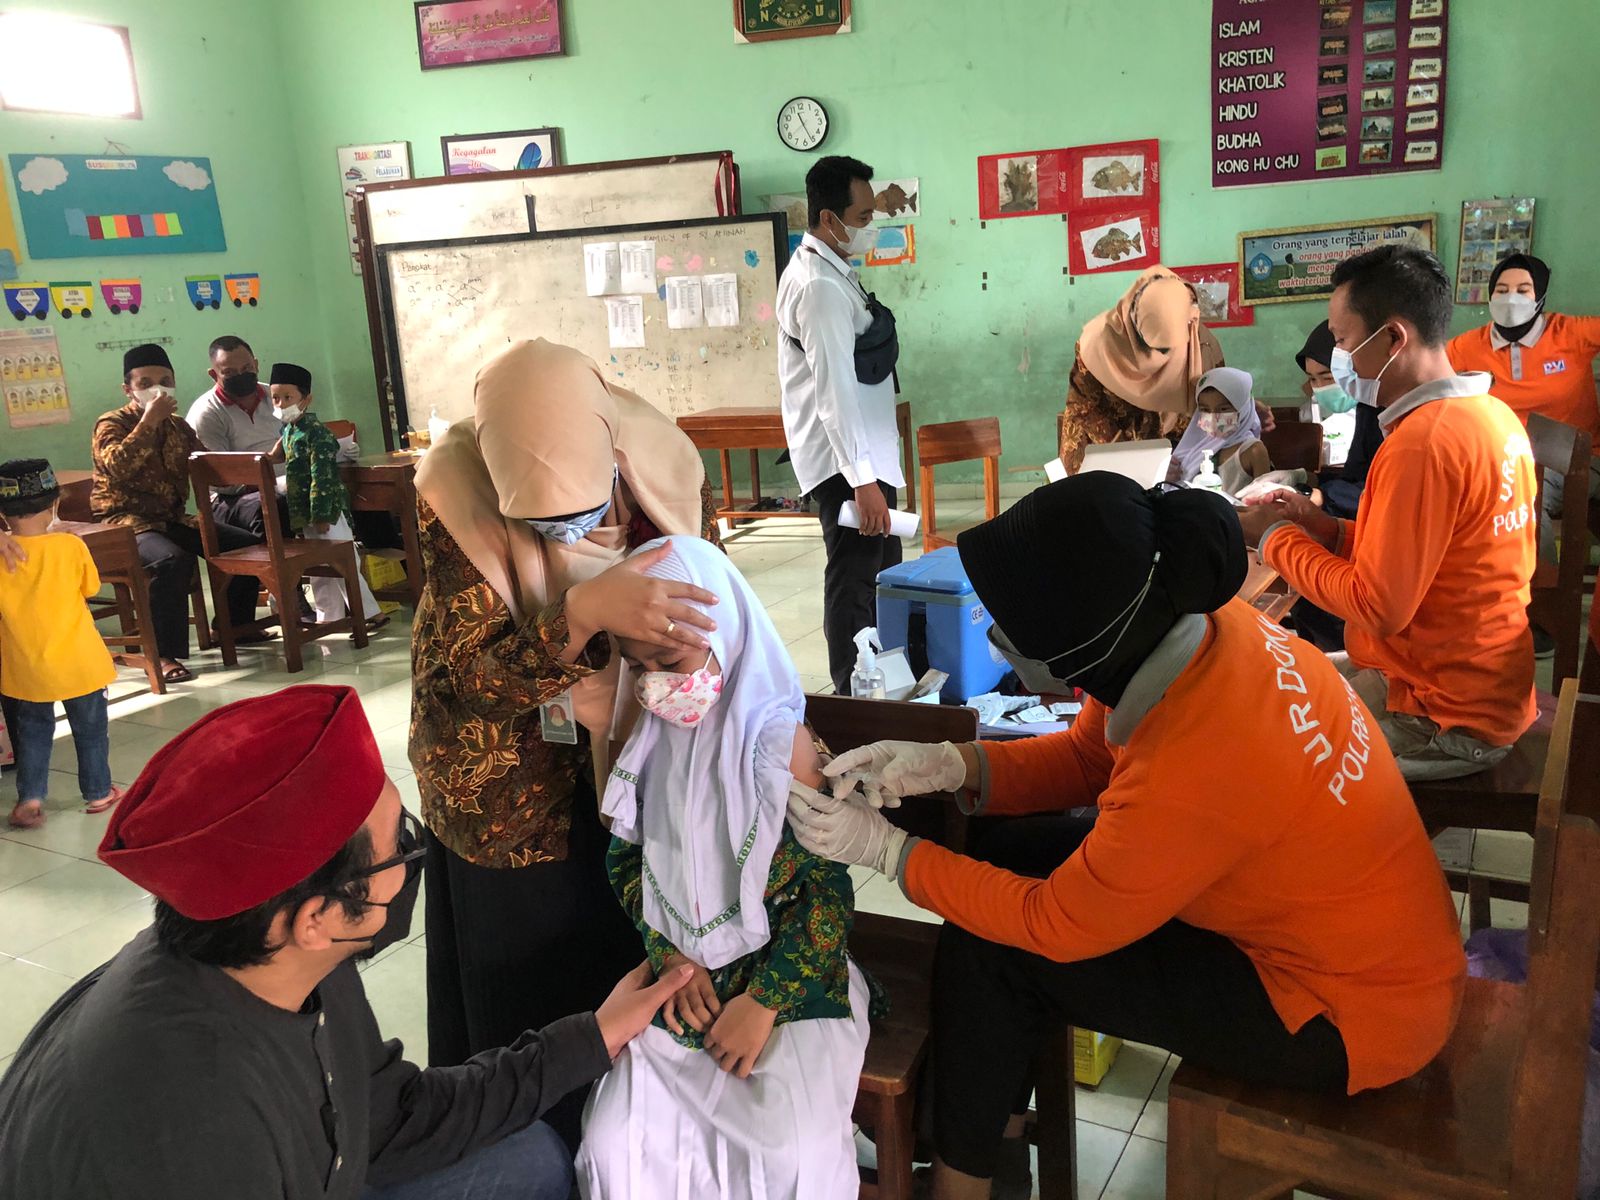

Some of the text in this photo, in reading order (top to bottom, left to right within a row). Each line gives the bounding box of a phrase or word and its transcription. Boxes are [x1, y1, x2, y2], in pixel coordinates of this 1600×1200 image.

[815, 4, 824, 17] U
[1218, 19, 1261, 39] ISLAM
[1218, 48, 1274, 68] KRISTEN
[1218, 72, 1285, 94] KHATOLIK
[1218, 103, 1258, 122] HINDU
[1216, 132, 1262, 151] BUDHA
[1216, 155, 1299, 174] KONG HU CHU
[1272, 229, 1407, 250] Orang yang terpelajar ialah
[1300, 252, 1322, 262] orang
[1324, 250, 1344, 260] yang
[1279, 274, 1331, 288] waktu terlua
